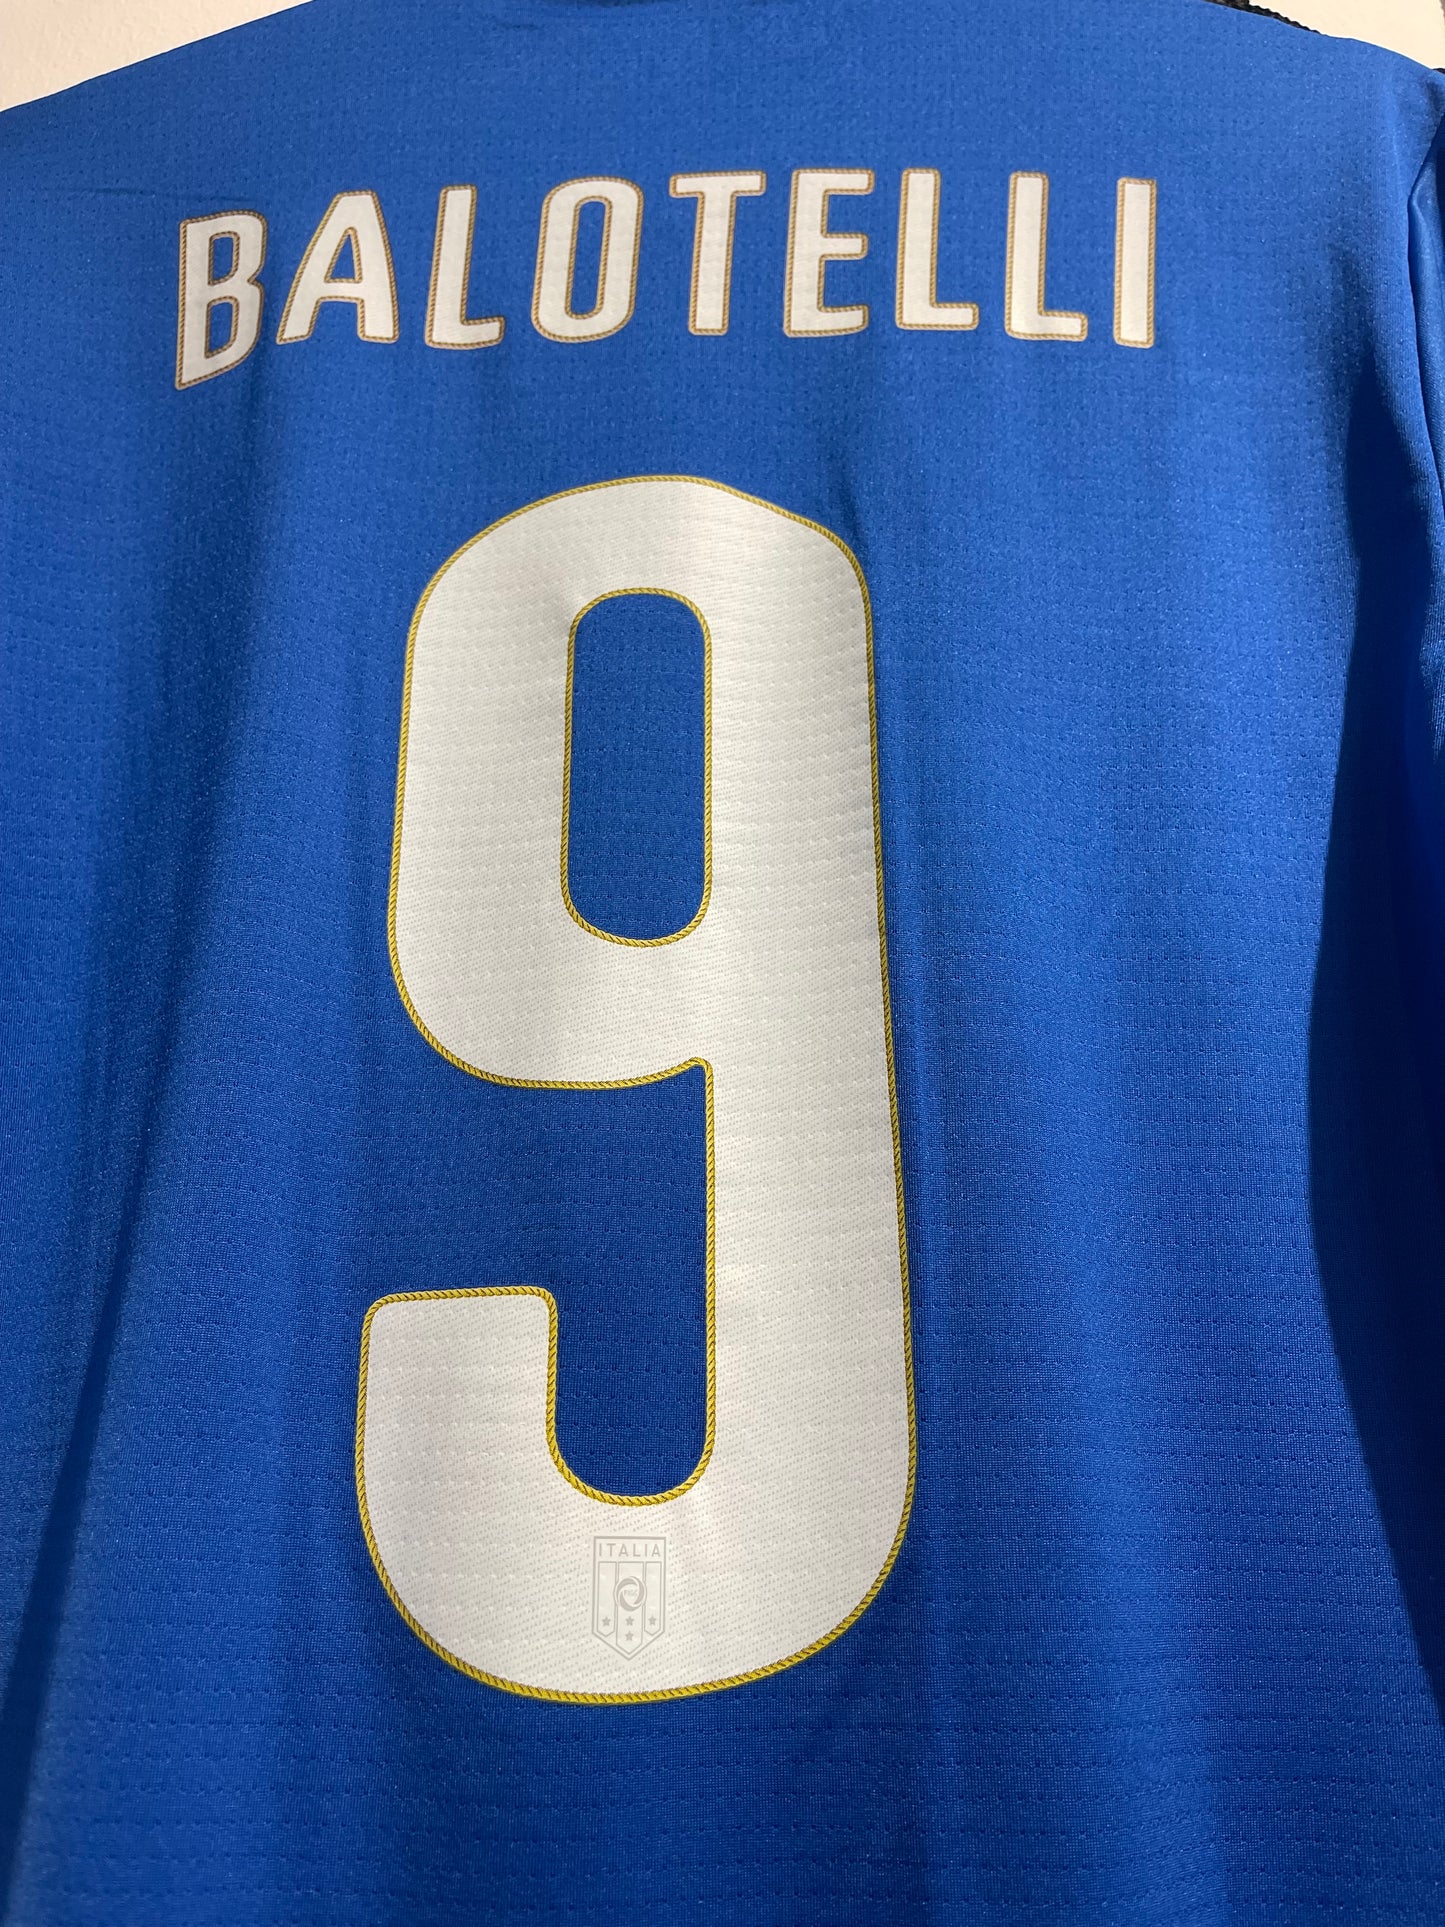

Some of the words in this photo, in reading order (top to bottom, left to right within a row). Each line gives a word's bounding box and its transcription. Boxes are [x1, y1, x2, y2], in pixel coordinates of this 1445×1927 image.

[174, 167, 1158, 391] BALOTELLI
[354, 473, 918, 1705] 9
[599, 1543, 661, 1557] ITALIA
